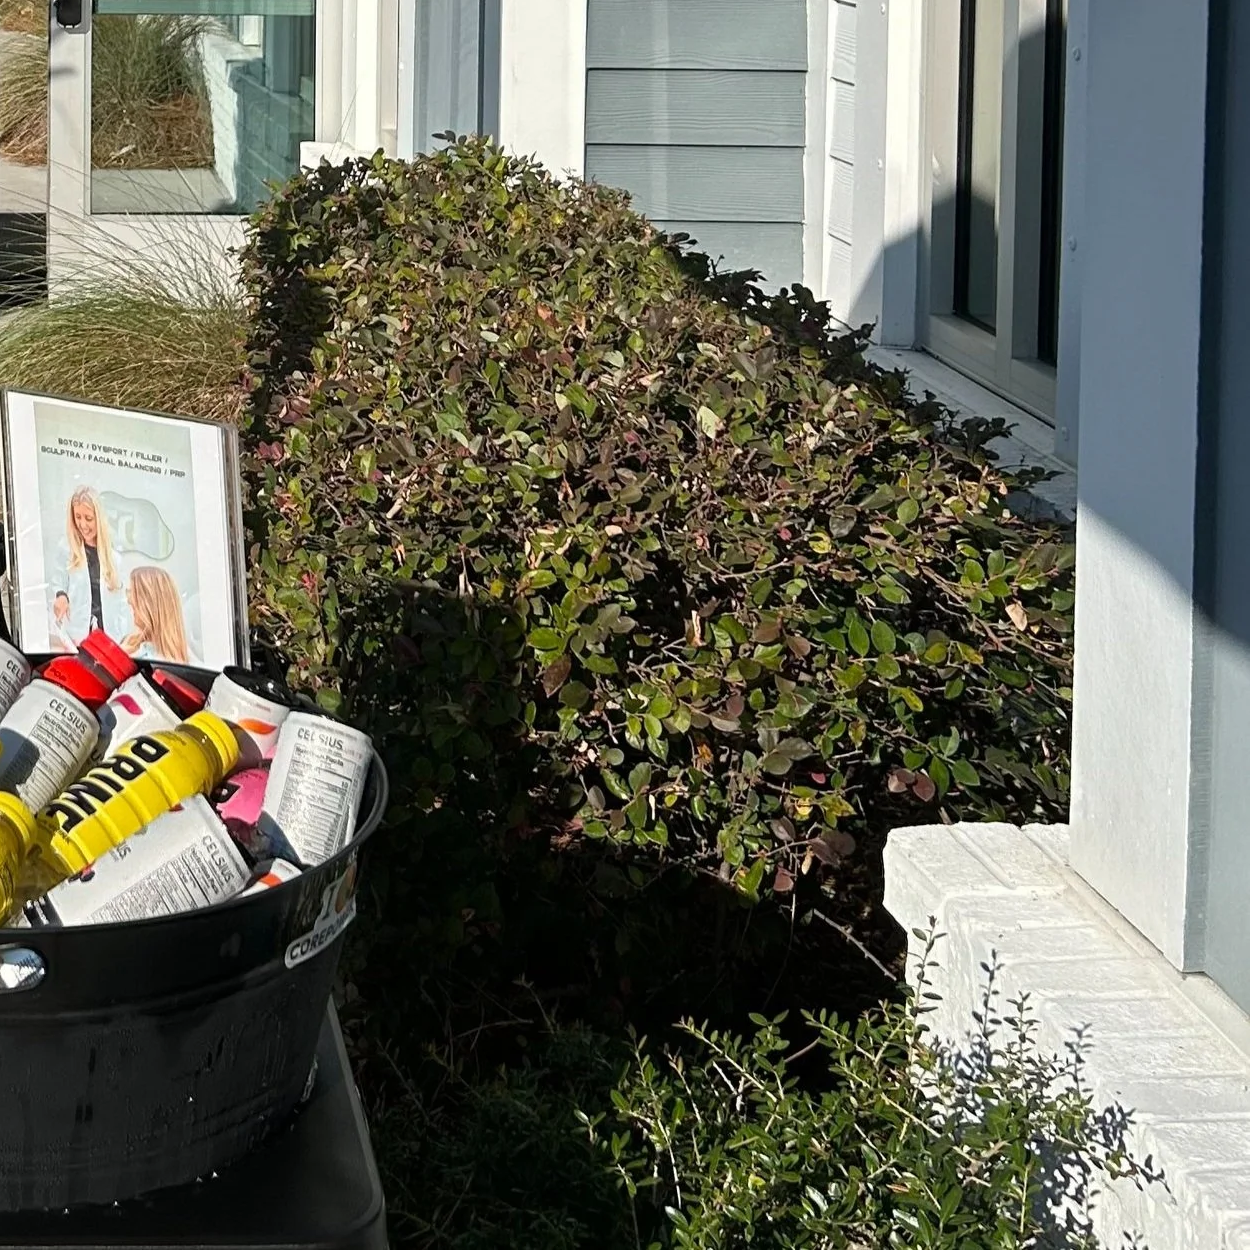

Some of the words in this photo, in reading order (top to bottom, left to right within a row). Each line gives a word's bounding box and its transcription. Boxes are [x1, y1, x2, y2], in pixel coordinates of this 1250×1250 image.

[41, 445, 81, 459] SCULPTRA
[88, 453, 115, 466] FACIAL
[117, 460, 162, 475] BALANCING
[58, 437, 84, 449] BOTOX
[91, 443, 128, 457] DYSPORT
[135, 451, 163, 462] FILLER
[49, 698, 88, 735] CELSIUS
[297, 727, 344, 751] CELSIUS
[202, 835, 235, 883] CELSIUS
